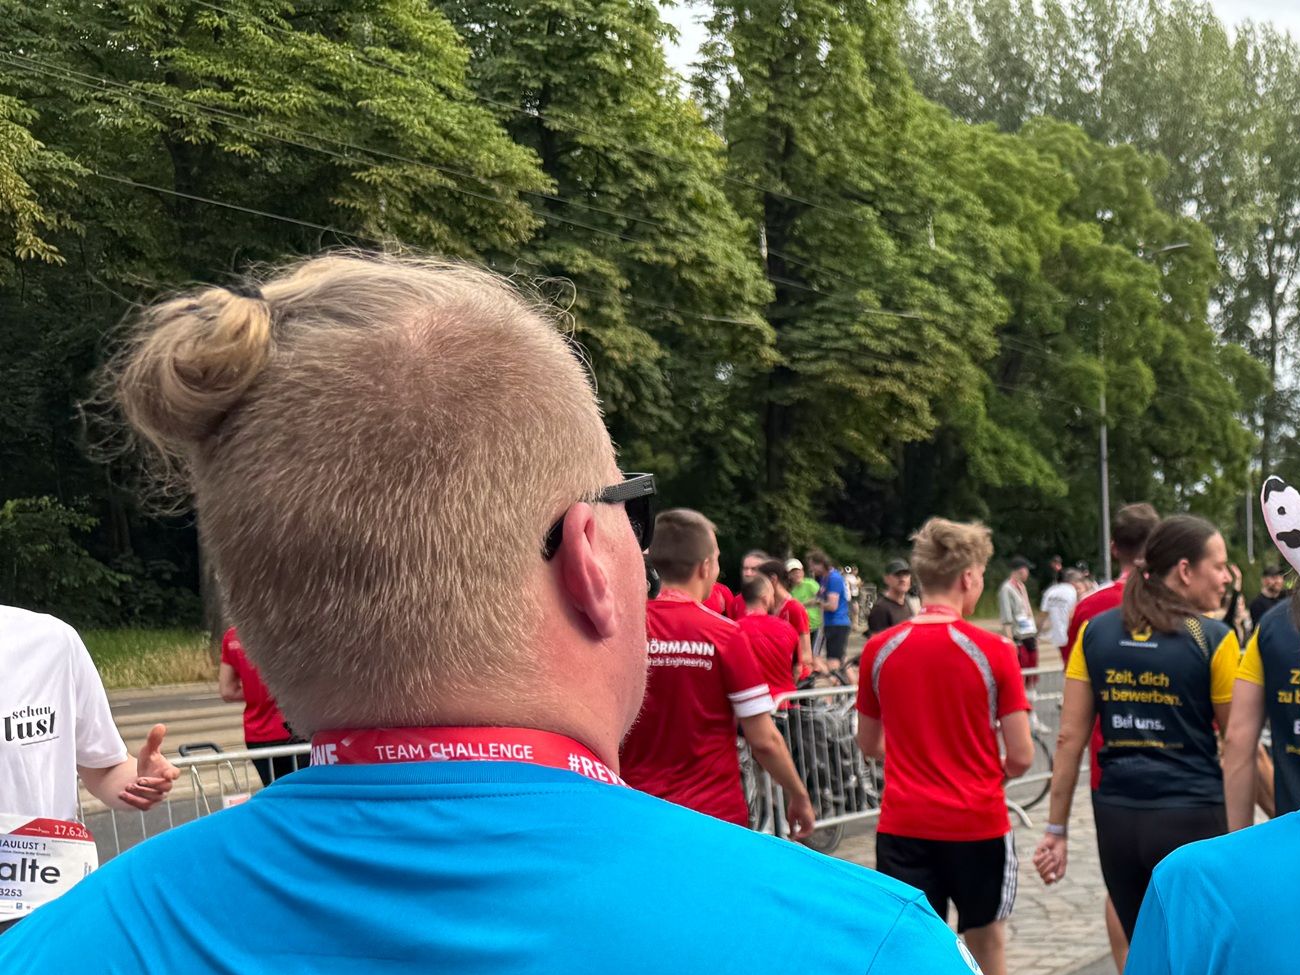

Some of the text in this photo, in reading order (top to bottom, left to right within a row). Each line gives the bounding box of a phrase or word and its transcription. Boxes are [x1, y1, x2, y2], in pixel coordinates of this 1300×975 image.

[665, 656, 713, 671] Engineering
[1105, 669, 1170, 687] Zeit, dich
[1111, 688, 1183, 706] bewerben.
[12, 705, 51, 719] schau
[1112, 713, 1166, 731] Bei uns.
[374, 743, 425, 760] TEAM
[430, 742, 534, 761] CHALLENGE
[568, 753, 632, 789] #REW
[54, 824, 89, 839] 17.6.26
